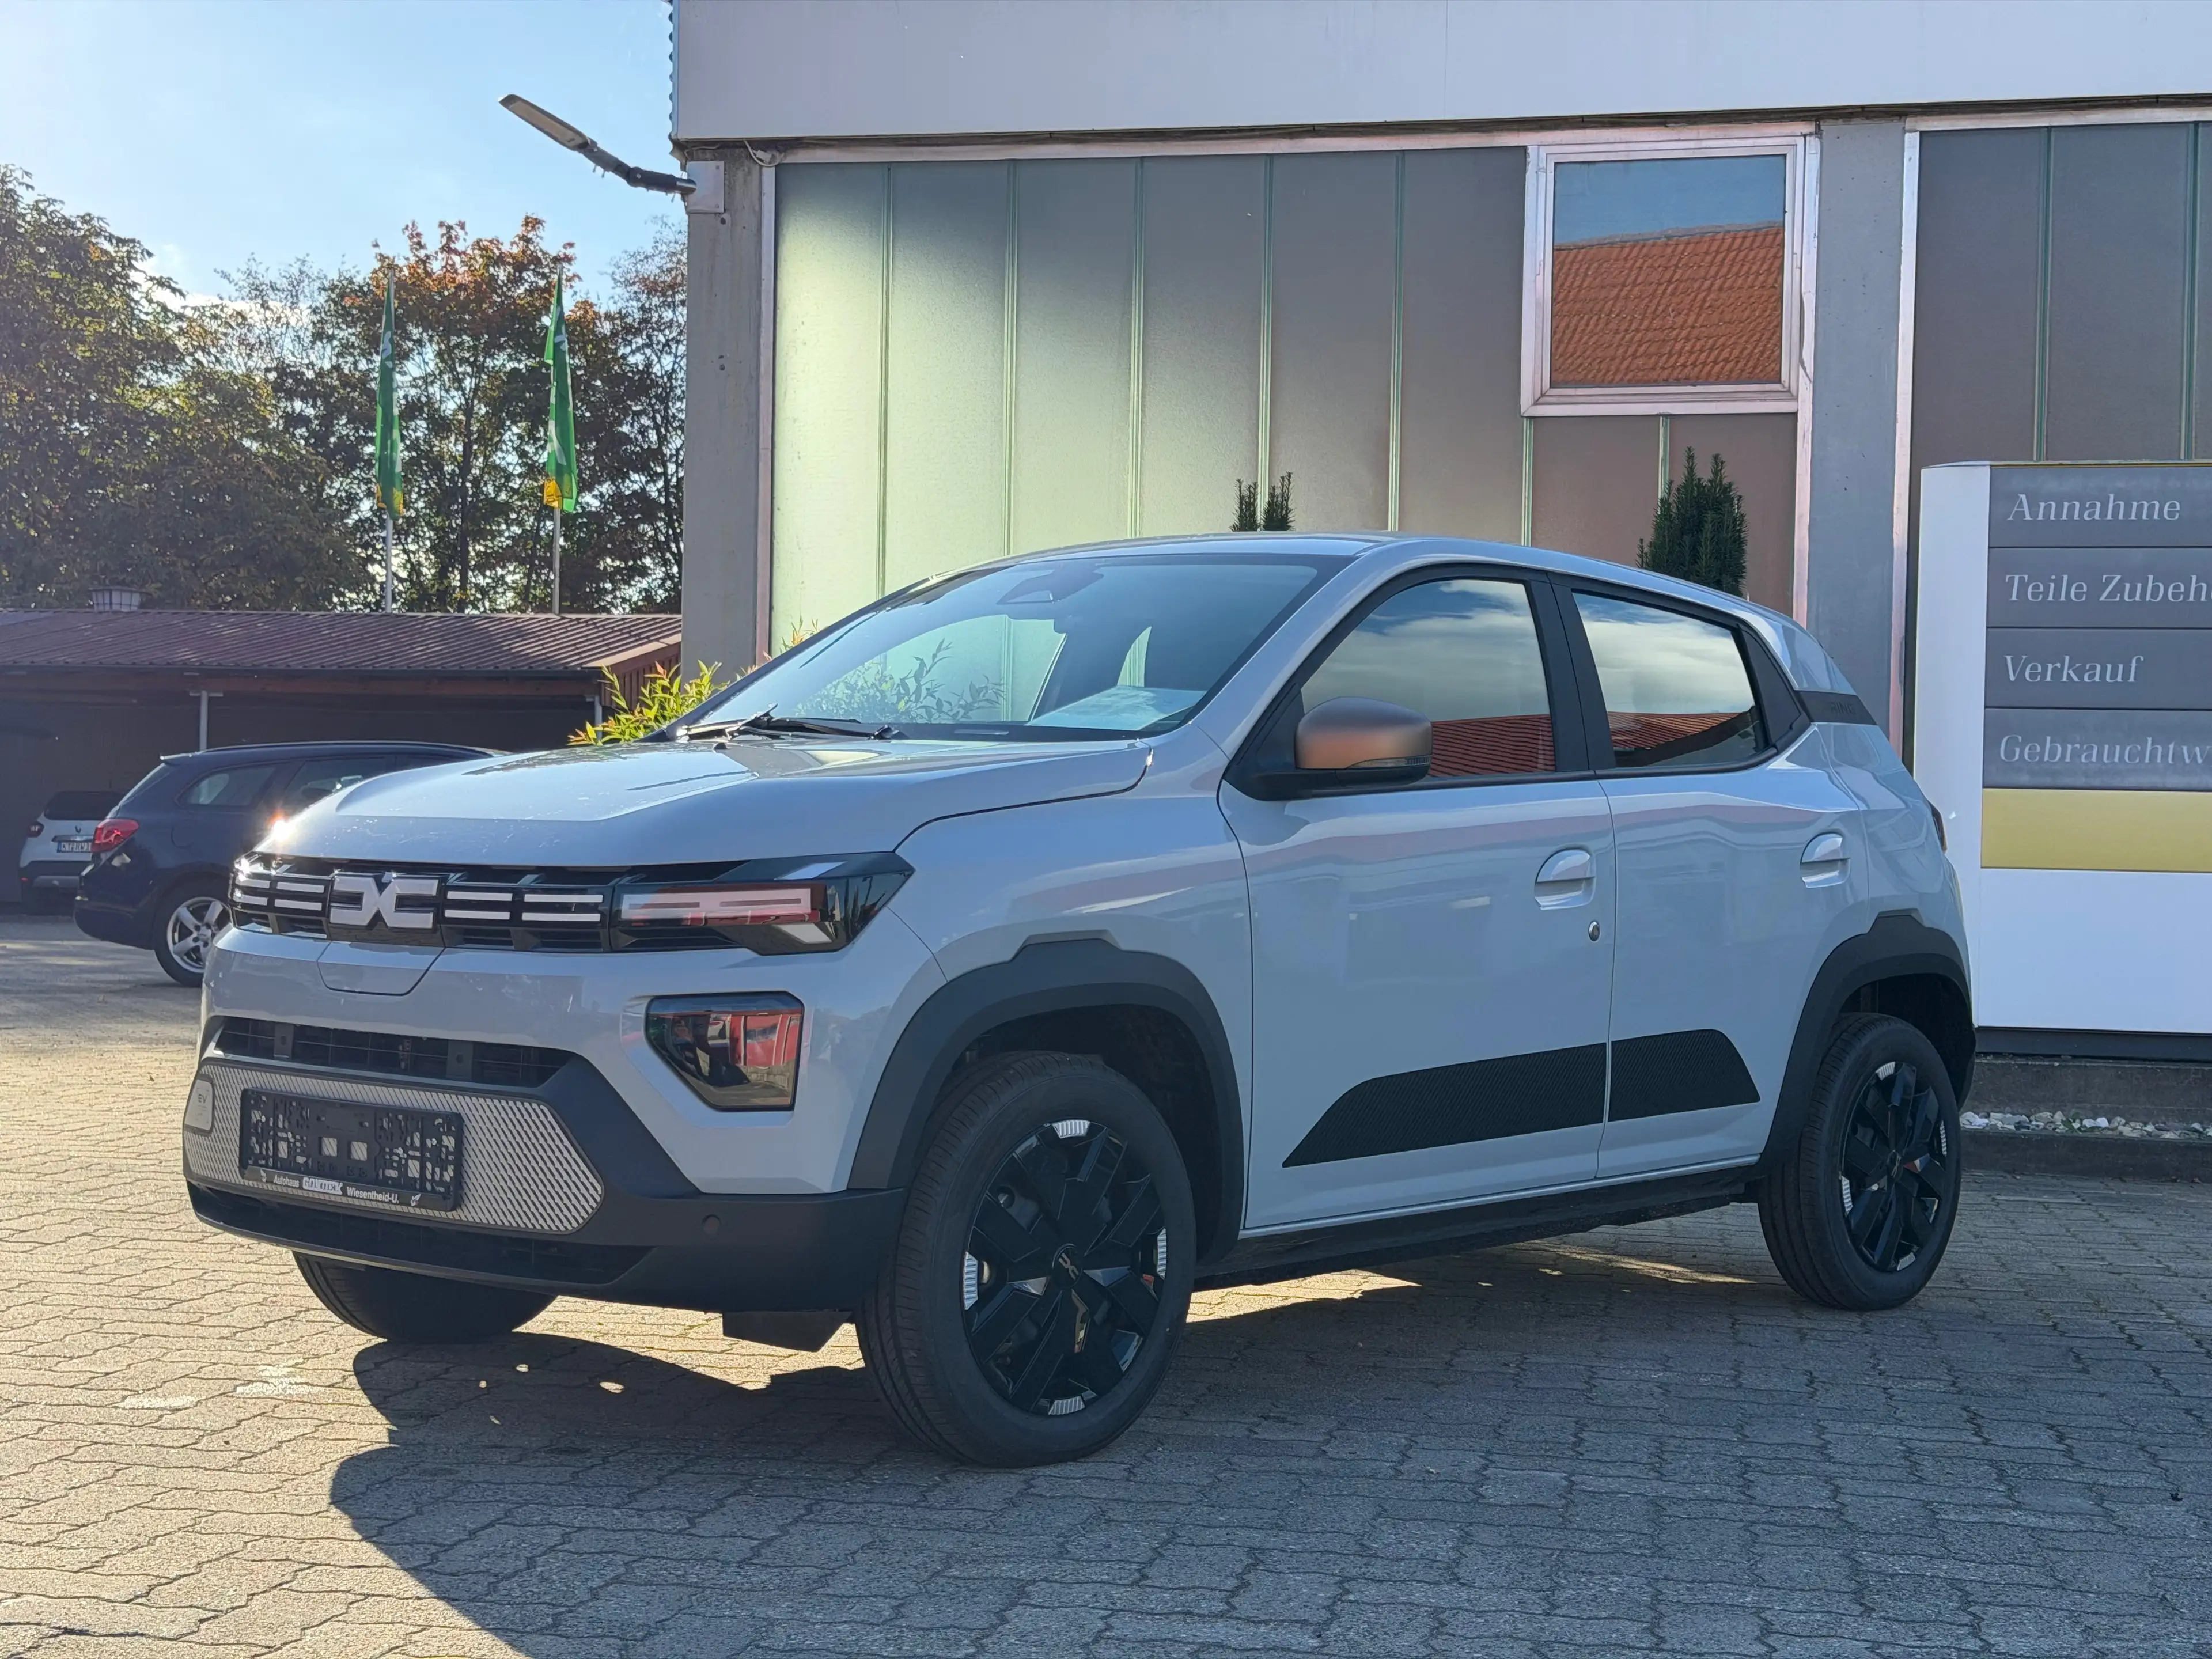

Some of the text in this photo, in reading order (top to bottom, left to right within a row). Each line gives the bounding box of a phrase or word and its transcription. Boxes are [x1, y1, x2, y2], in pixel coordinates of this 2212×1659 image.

[2007, 494, 2181, 520] Annahme
[2005, 574, 2212, 602] Teile Zubeh
[2005, 655, 2143, 682] Verkauf
[1999, 735, 2212, 764] Gebrauchtw
[274, 1174, 300, 1188] Autohaus
